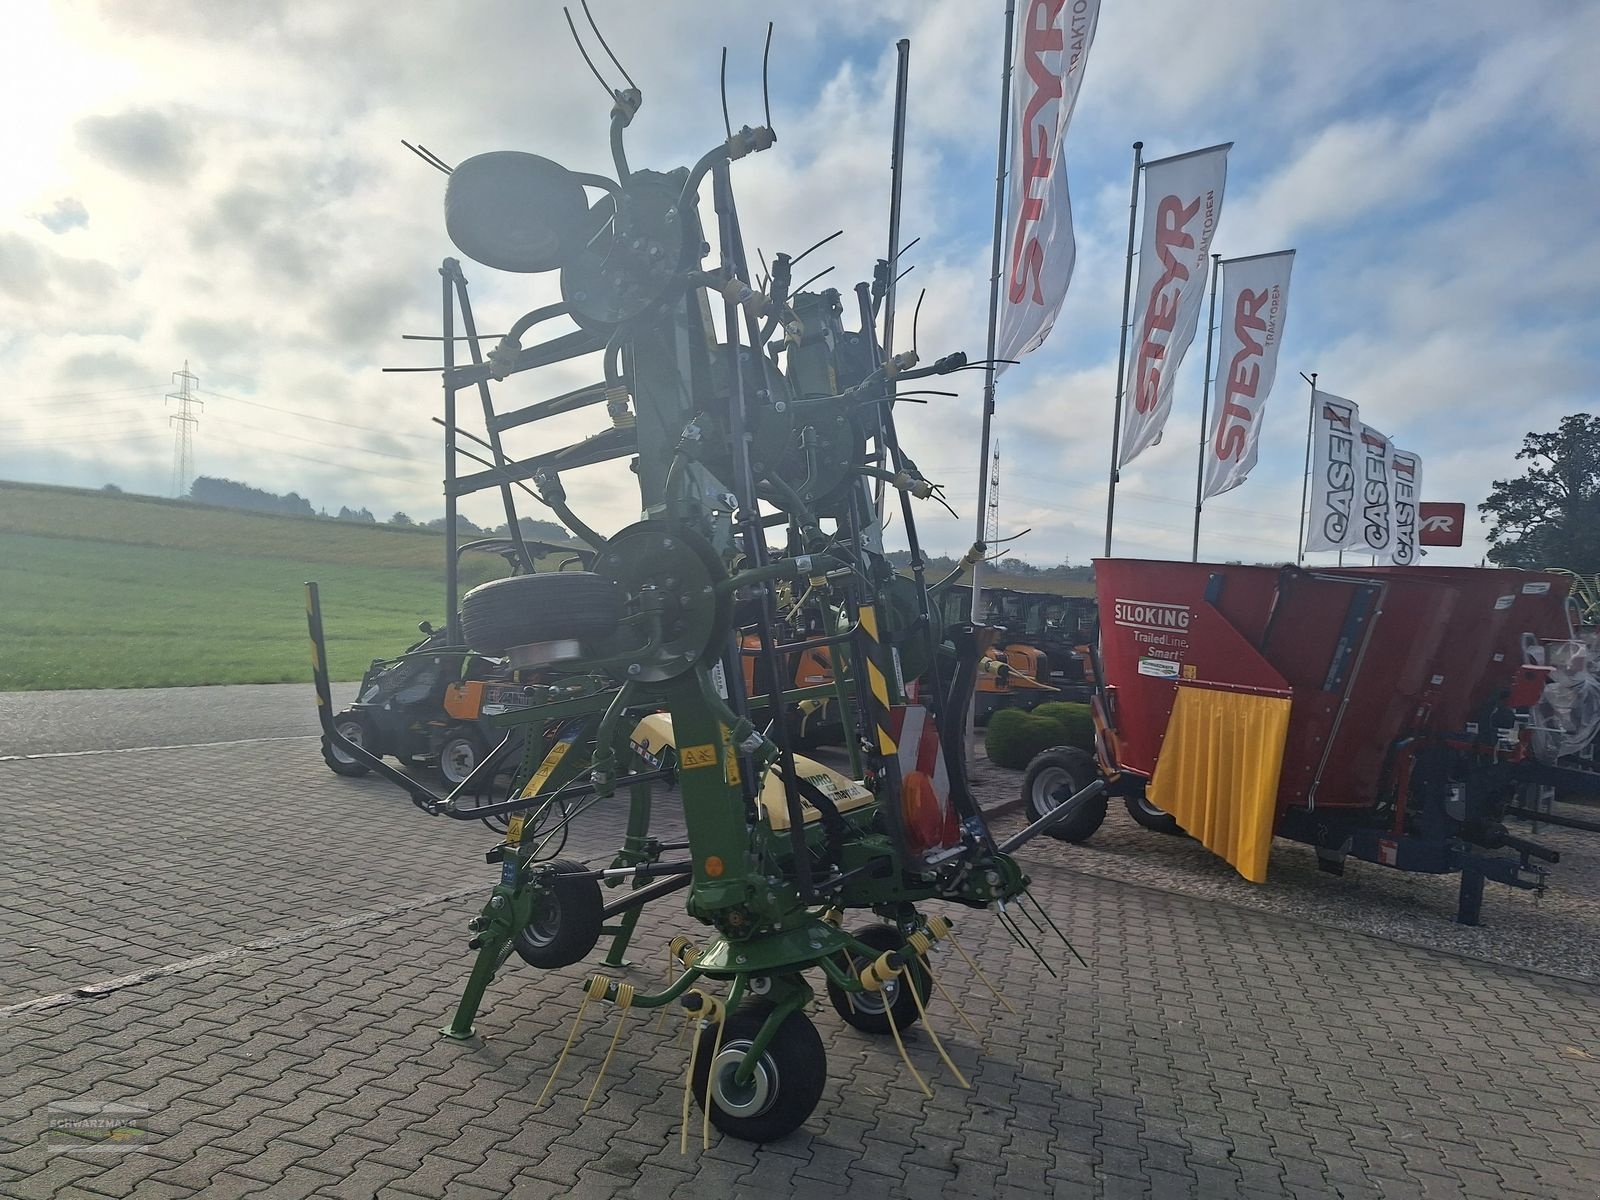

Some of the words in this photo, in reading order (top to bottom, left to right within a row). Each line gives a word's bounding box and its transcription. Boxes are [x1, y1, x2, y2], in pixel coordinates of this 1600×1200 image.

[1135, 194, 1201, 415] STEYR
[1215, 287, 1269, 463] STEYR
[1324, 434, 1354, 543] CASE
[1364, 457, 1389, 549] CASE
[1392, 482, 1416, 566] CASE
[1115, 604, 1189, 627] SILOKING
[1147, 646, 1179, 660] Smart
